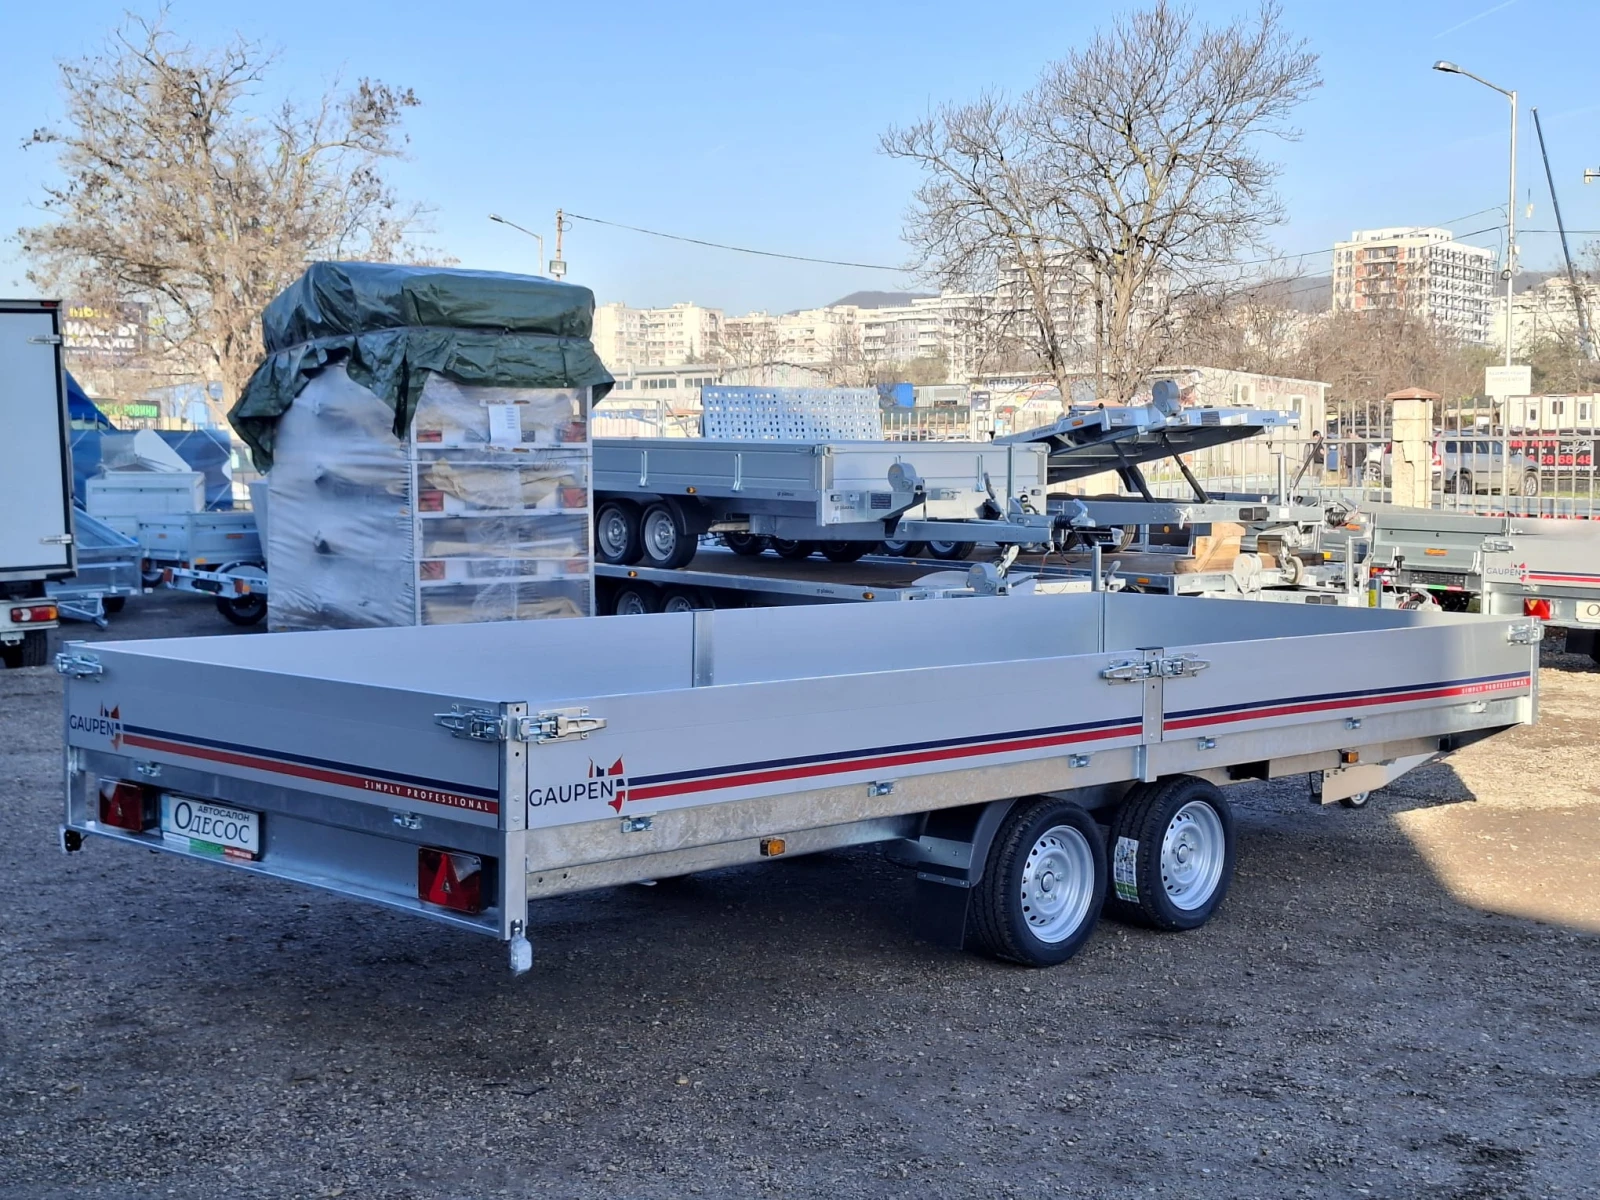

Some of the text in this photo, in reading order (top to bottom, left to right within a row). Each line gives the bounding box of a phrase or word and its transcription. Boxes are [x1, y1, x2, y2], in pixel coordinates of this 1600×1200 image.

[1486, 567, 1521, 576] GAUPEN
[1461, 679, 1527, 694] SIMPLY PROFESSIONAL
[69, 714, 114, 736] GAUPEN
[364, 780, 490, 812] SIMPLY PROFESSIONAL
[529, 779, 613, 807] GAUPEN
[198, 804, 250, 821] АВТОСАЛОН
